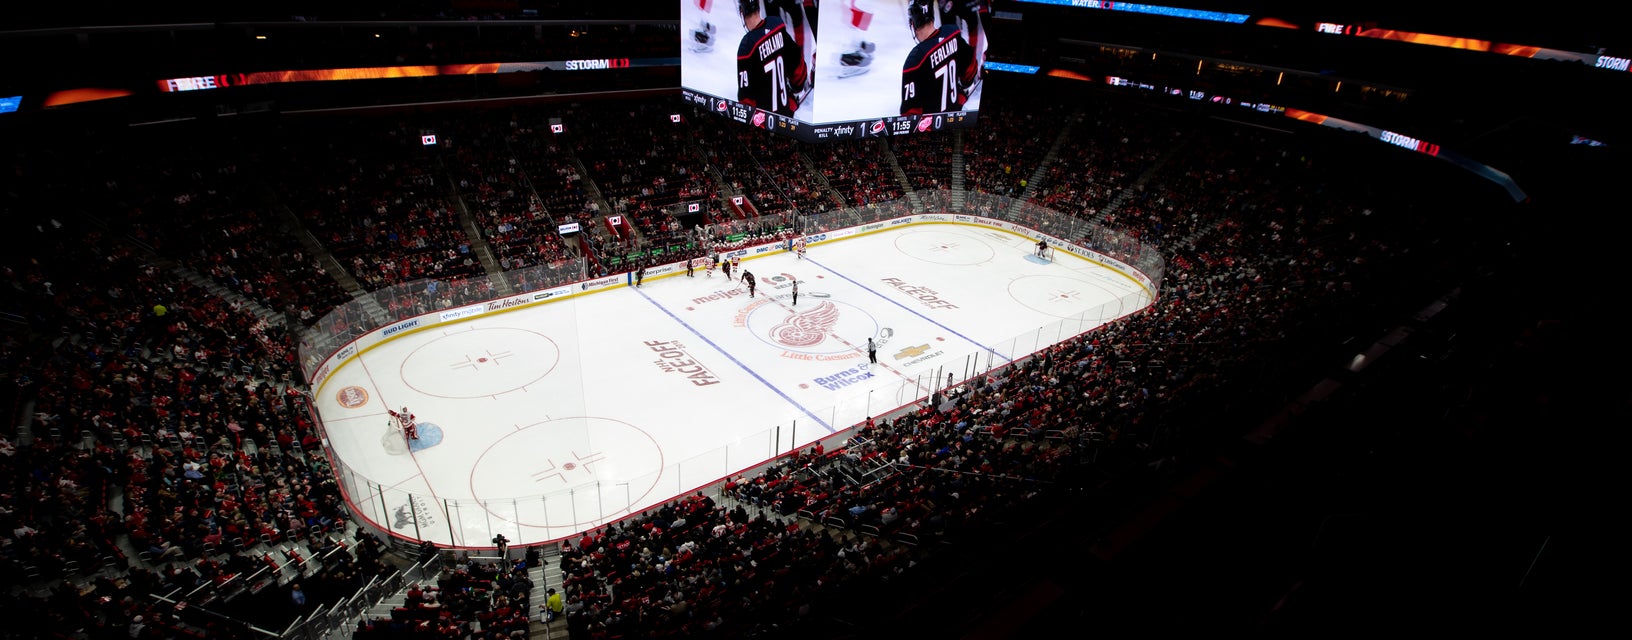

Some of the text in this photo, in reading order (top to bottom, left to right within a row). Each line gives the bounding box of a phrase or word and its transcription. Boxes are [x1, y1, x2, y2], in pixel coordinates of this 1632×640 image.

[1317, 23, 1343, 34] FIRE
[758, 32, 785, 61] FERLAND
[930, 38, 958, 69] FERLAND
[1595, 55, 1631, 71] STORM
[739, 70, 749, 88] 79
[763, 55, 787, 112] 79
[934, 59, 957, 112] 79
[904, 81, 915, 101] 79
[732, 107, 747, 119] 11:55
[768, 115, 774, 129] 0
[860, 122, 866, 137] 1
[893, 121, 910, 131] 11:55
[934, 115, 942, 129] 0
[834, 126, 854, 137] xfinity
[487, 298, 530, 311] Tim Hortons
[383, 320, 418, 336] BUD LIGHT
[781, 350, 814, 362] Little
[813, 366, 855, 386] Burns
[824, 371, 876, 391] Wilcox
